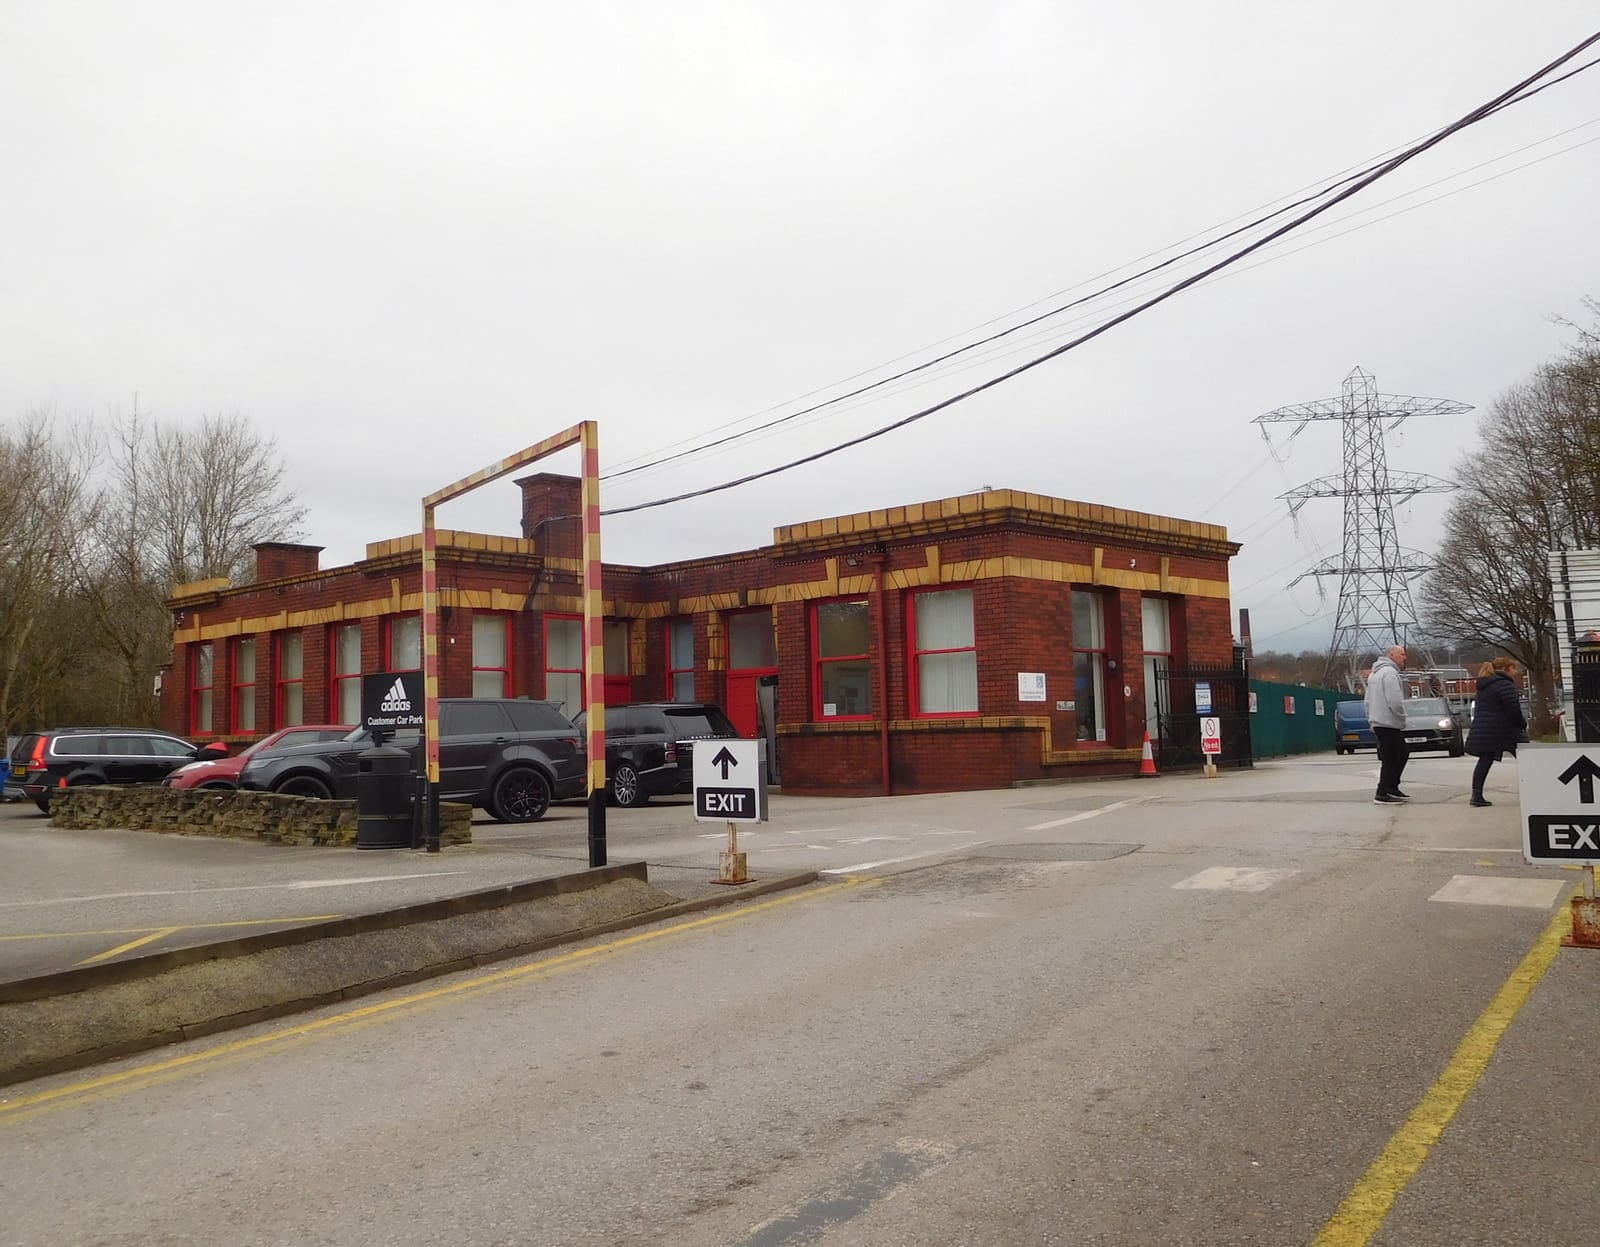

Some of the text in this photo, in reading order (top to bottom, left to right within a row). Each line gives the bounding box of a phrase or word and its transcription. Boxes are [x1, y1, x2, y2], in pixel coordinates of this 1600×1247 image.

[381, 699, 411, 711] adidas
[368, 715, 423, 725] Customer Car Park
[705, 793, 746, 812] EXIT
[1547, 823, 1600, 850] EX
